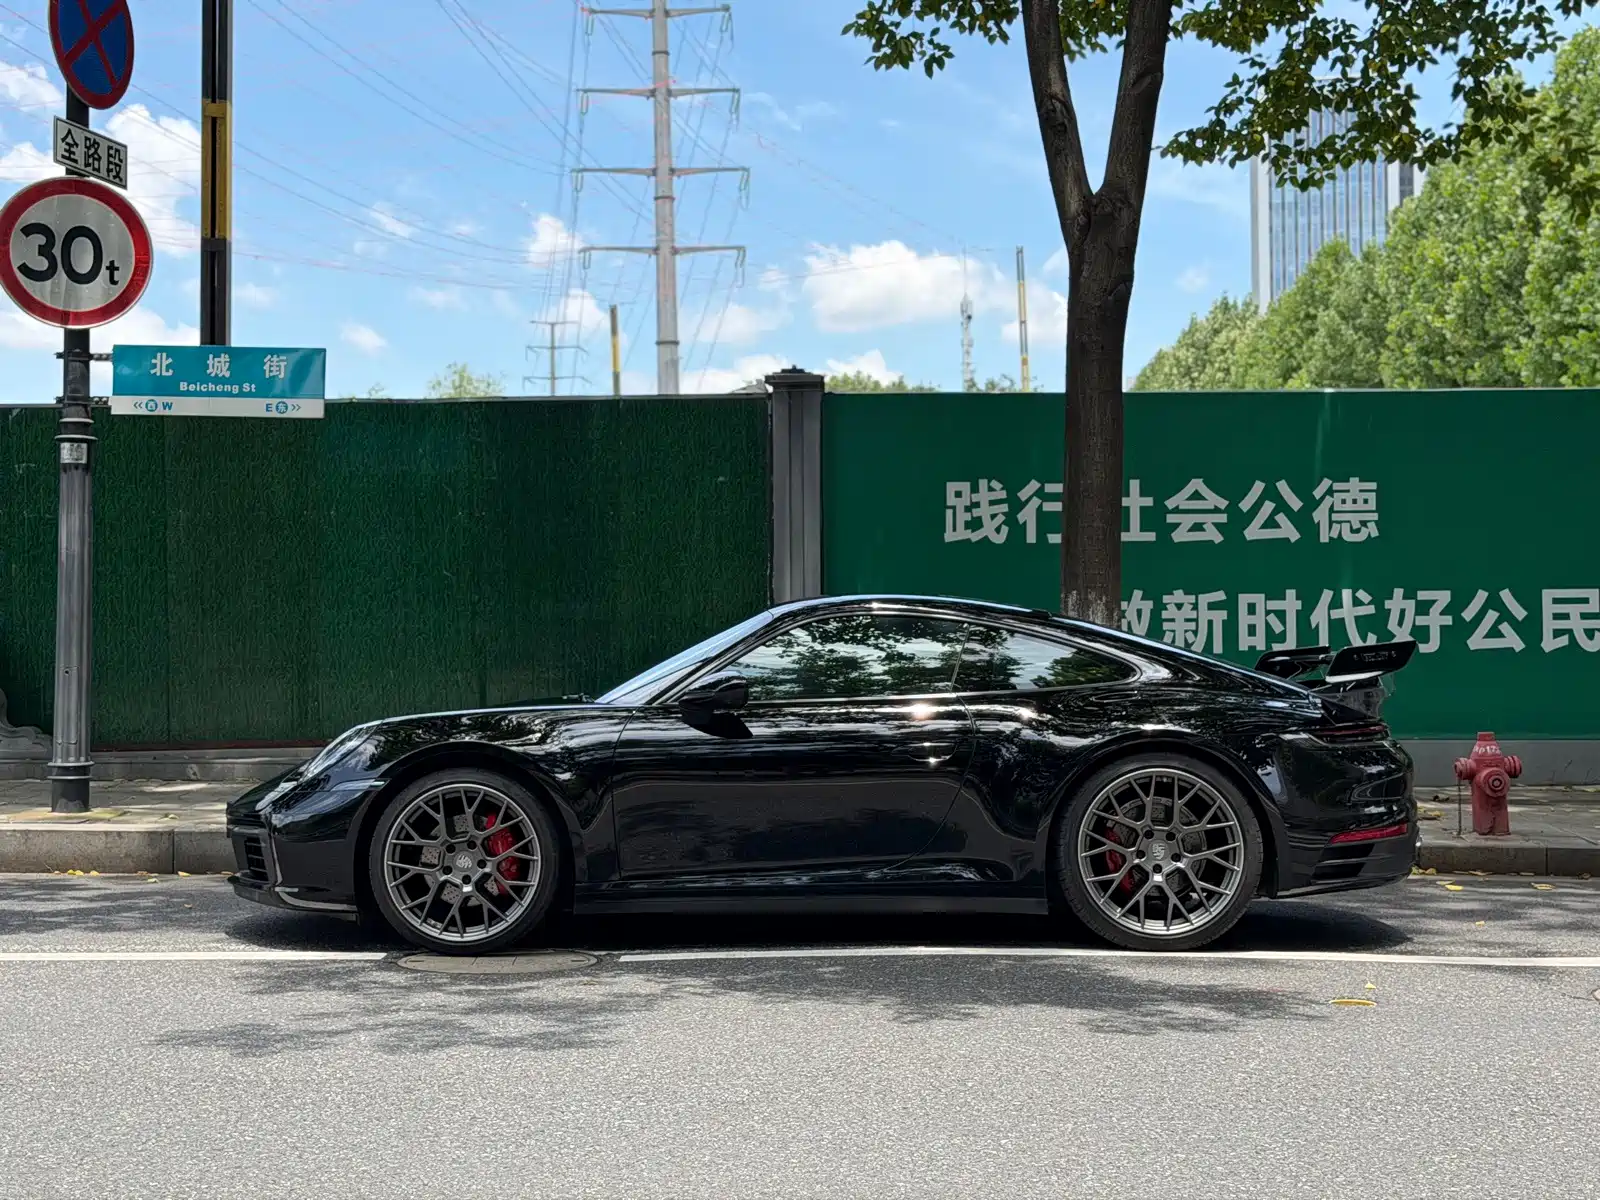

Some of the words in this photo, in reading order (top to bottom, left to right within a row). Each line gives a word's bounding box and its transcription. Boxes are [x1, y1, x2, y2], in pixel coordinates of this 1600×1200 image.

[61, 128, 123, 181] 全路段
[151, 352, 287, 379] 北城街
[180, 381, 239, 394] Beicheng
[242, 382, 256, 392] St
[162, 401, 173, 411] W
[265, 403, 273, 412] E
